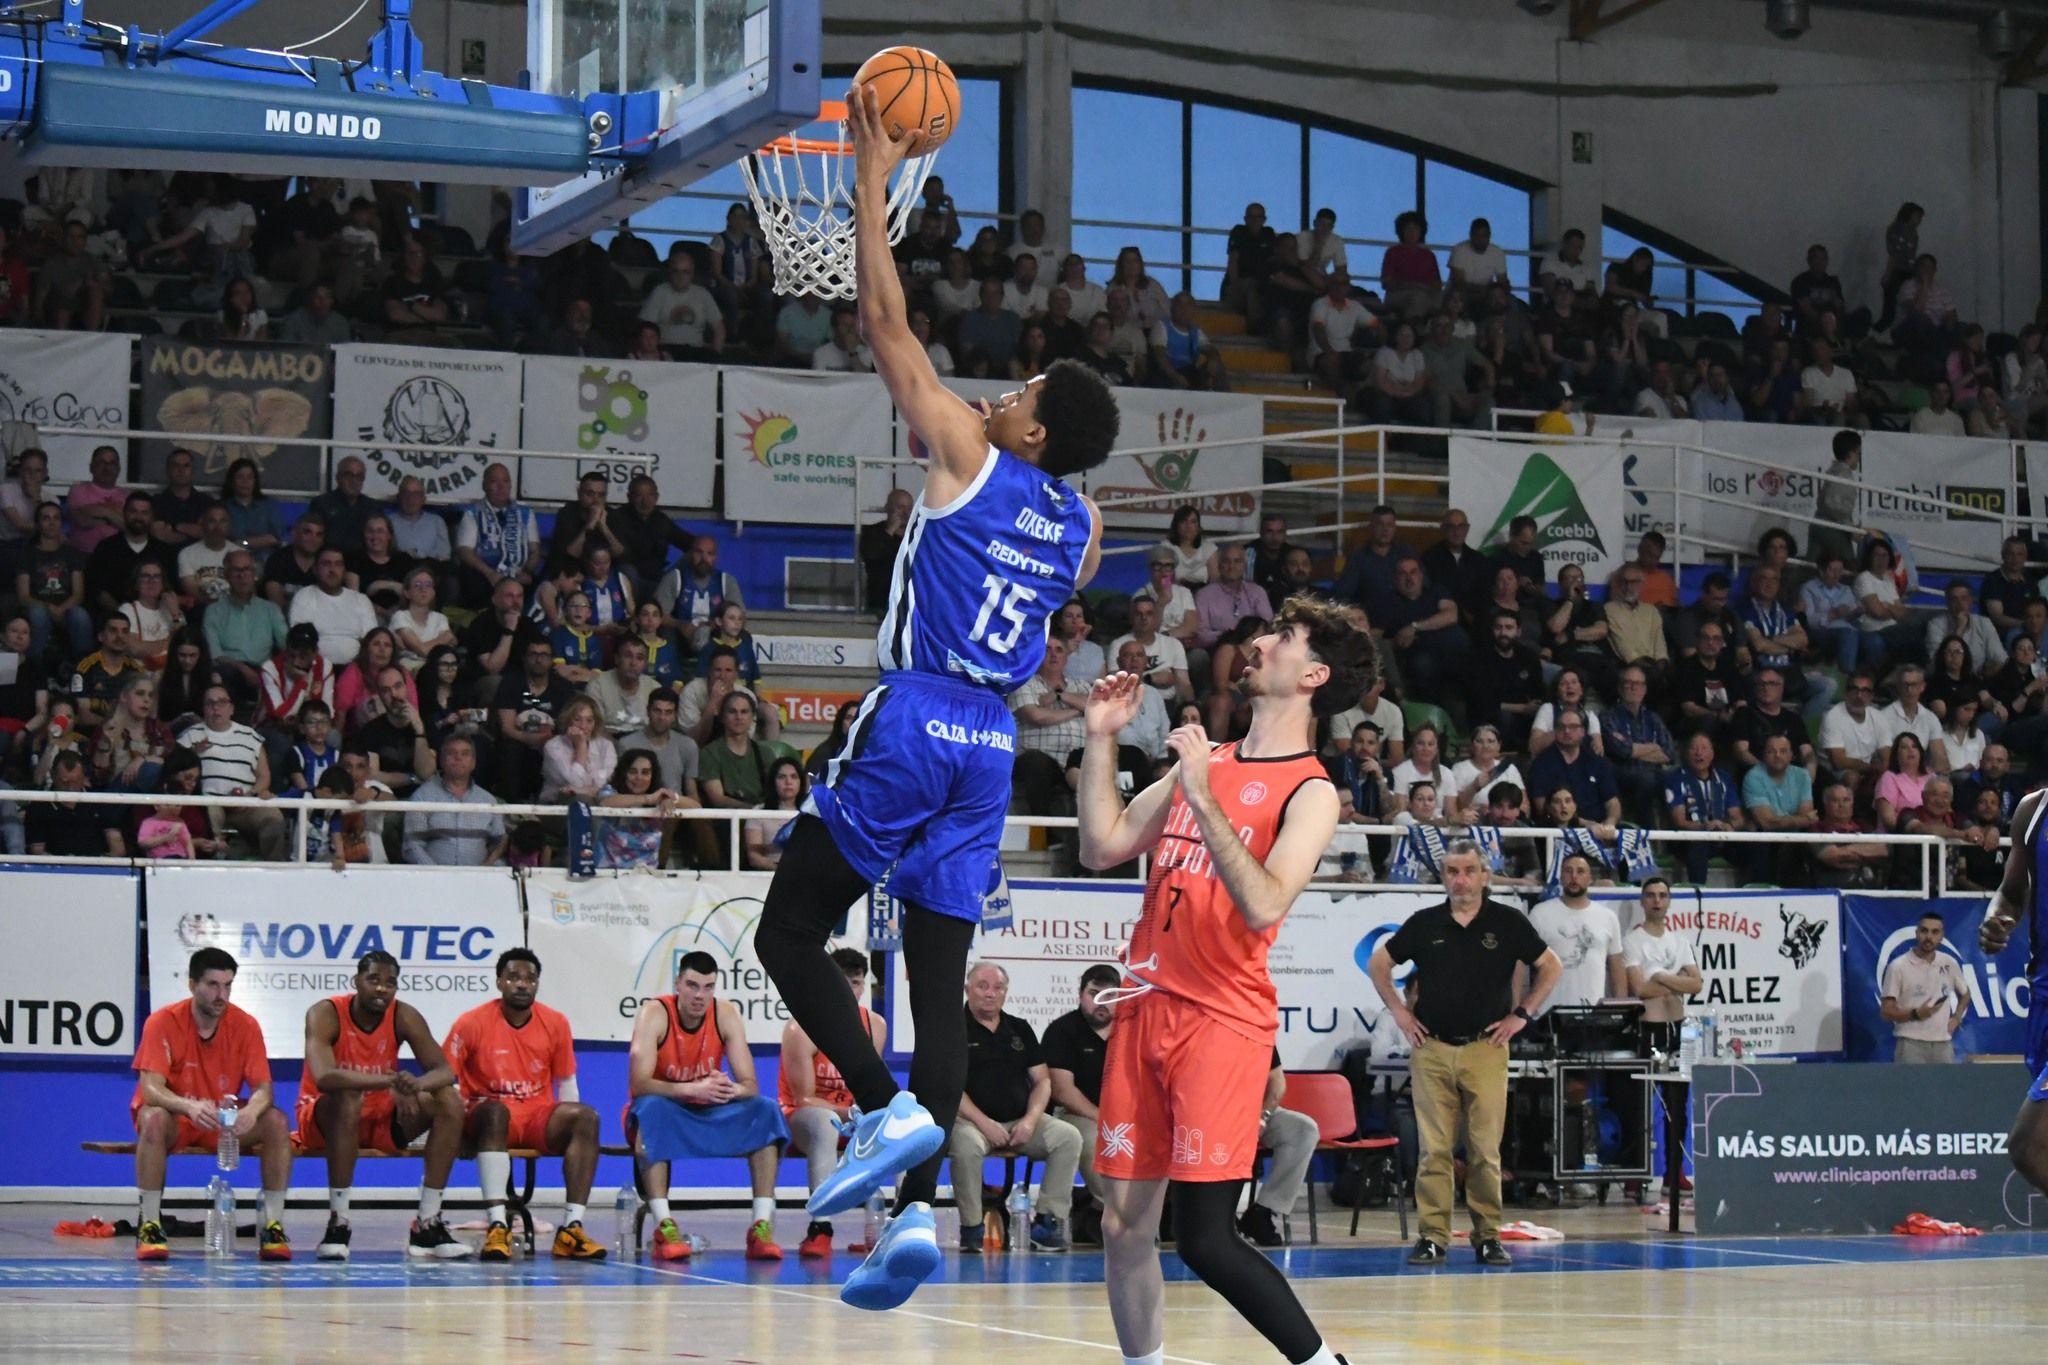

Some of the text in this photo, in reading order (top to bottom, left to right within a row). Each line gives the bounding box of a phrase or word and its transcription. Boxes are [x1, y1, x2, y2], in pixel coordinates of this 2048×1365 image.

[265, 109, 381, 140] MONDO
[151, 344, 324, 383] MOGAMBO
[412, 360, 426, 368] DE
[774, 452, 801, 467] LPS
[774, 473, 857, 488] safe working
[1708, 472, 1738, 494] los
[1547, 522, 1595, 539] coebb
[968, 574, 1038, 653] 15
[785, 697, 838, 721] Tele
[926, 719, 969, 745] CAJA
[1161, 886, 1184, 934] 7
[240, 922, 495, 961] NOVATEC
[400, 974, 489, 992] SESORES
[1724, 1012, 1775, 1024] PLANTA BAJA
[1718, 1130, 1774, 1159] MÁS
[1780, 1134, 1871, 1158] SALUD.
[1876, 1128, 1931, 1157] MÁS
[1774, 1166, 1977, 1185] www.clinicaponferrada.es
